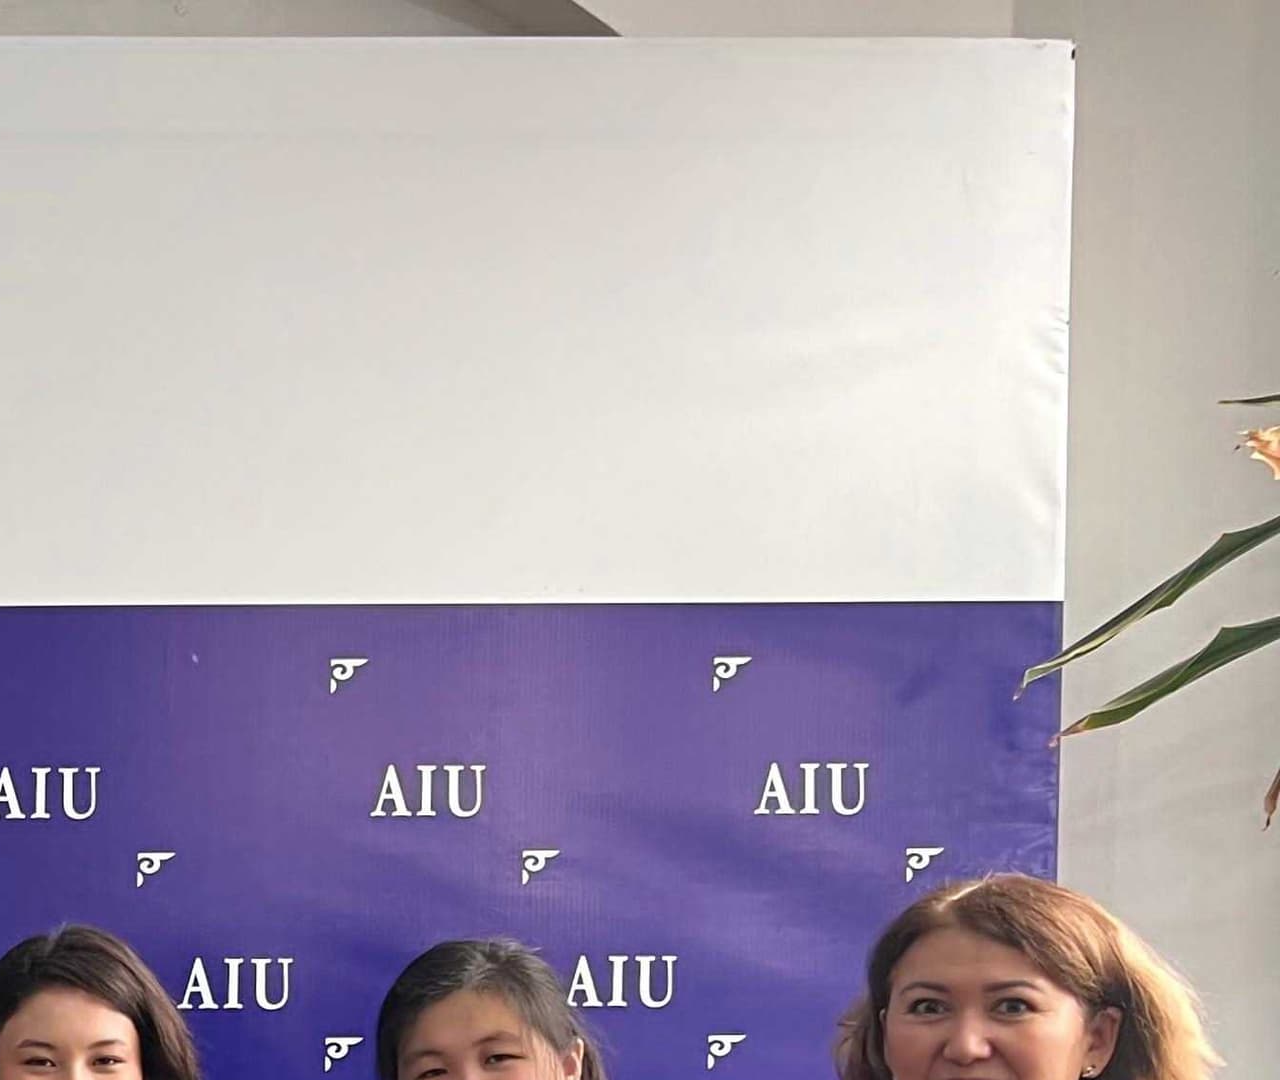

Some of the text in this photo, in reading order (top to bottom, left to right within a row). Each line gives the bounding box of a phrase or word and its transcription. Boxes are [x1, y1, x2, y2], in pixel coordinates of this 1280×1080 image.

[369, 763, 487, 818] AIU
[753, 761, 870, 816] AIU
[176, 957, 294, 1010] AIU
[566, 954, 678, 1008] AIU
